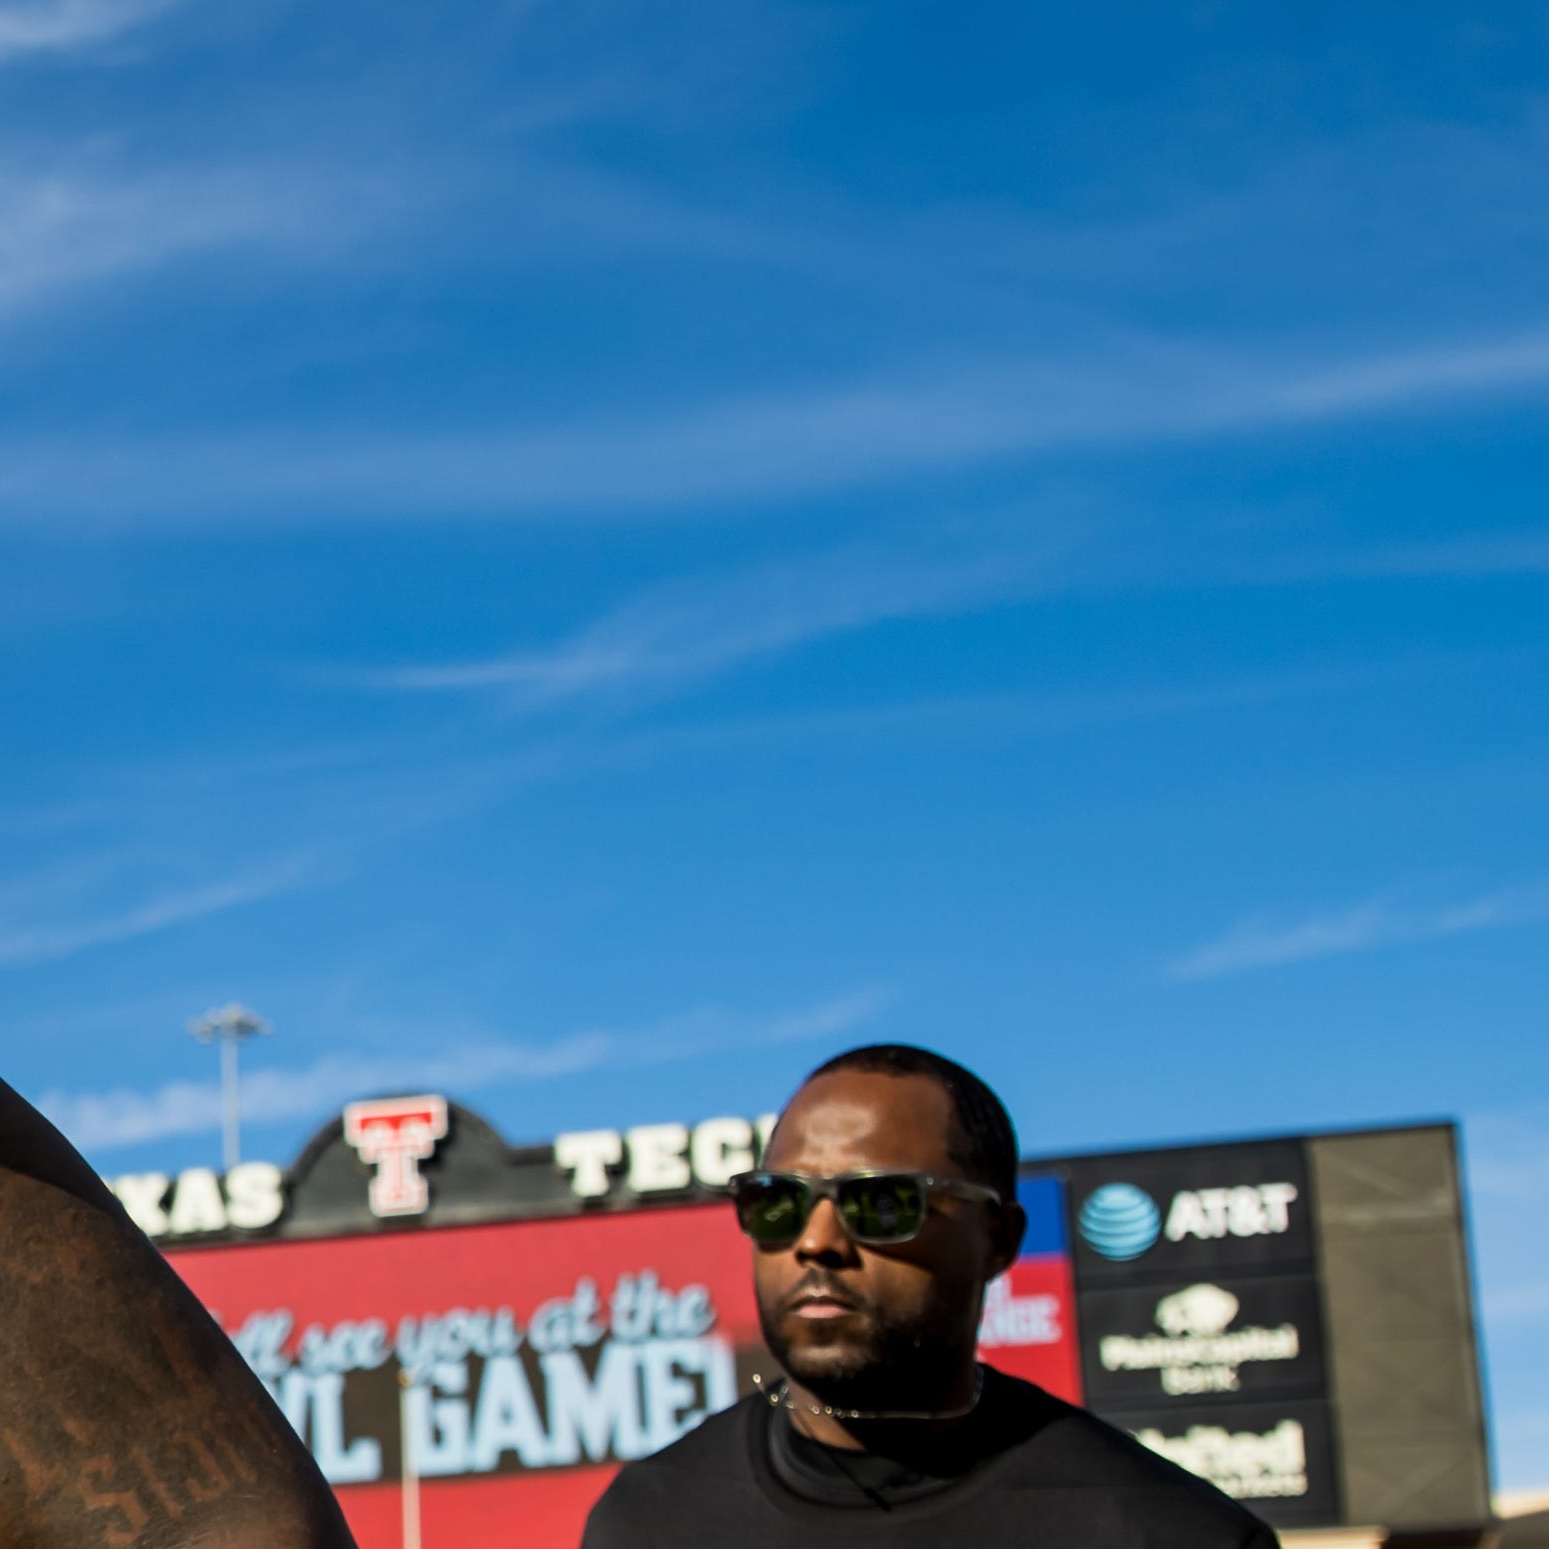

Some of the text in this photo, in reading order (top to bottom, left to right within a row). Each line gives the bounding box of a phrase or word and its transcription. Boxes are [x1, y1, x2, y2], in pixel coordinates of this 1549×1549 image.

[554, 1113, 778, 1198] TEC
[105, 1161, 285, 1237] XAS
[1164, 1181, 1299, 1243] AT&T
[610, 1265, 717, 1343] the
